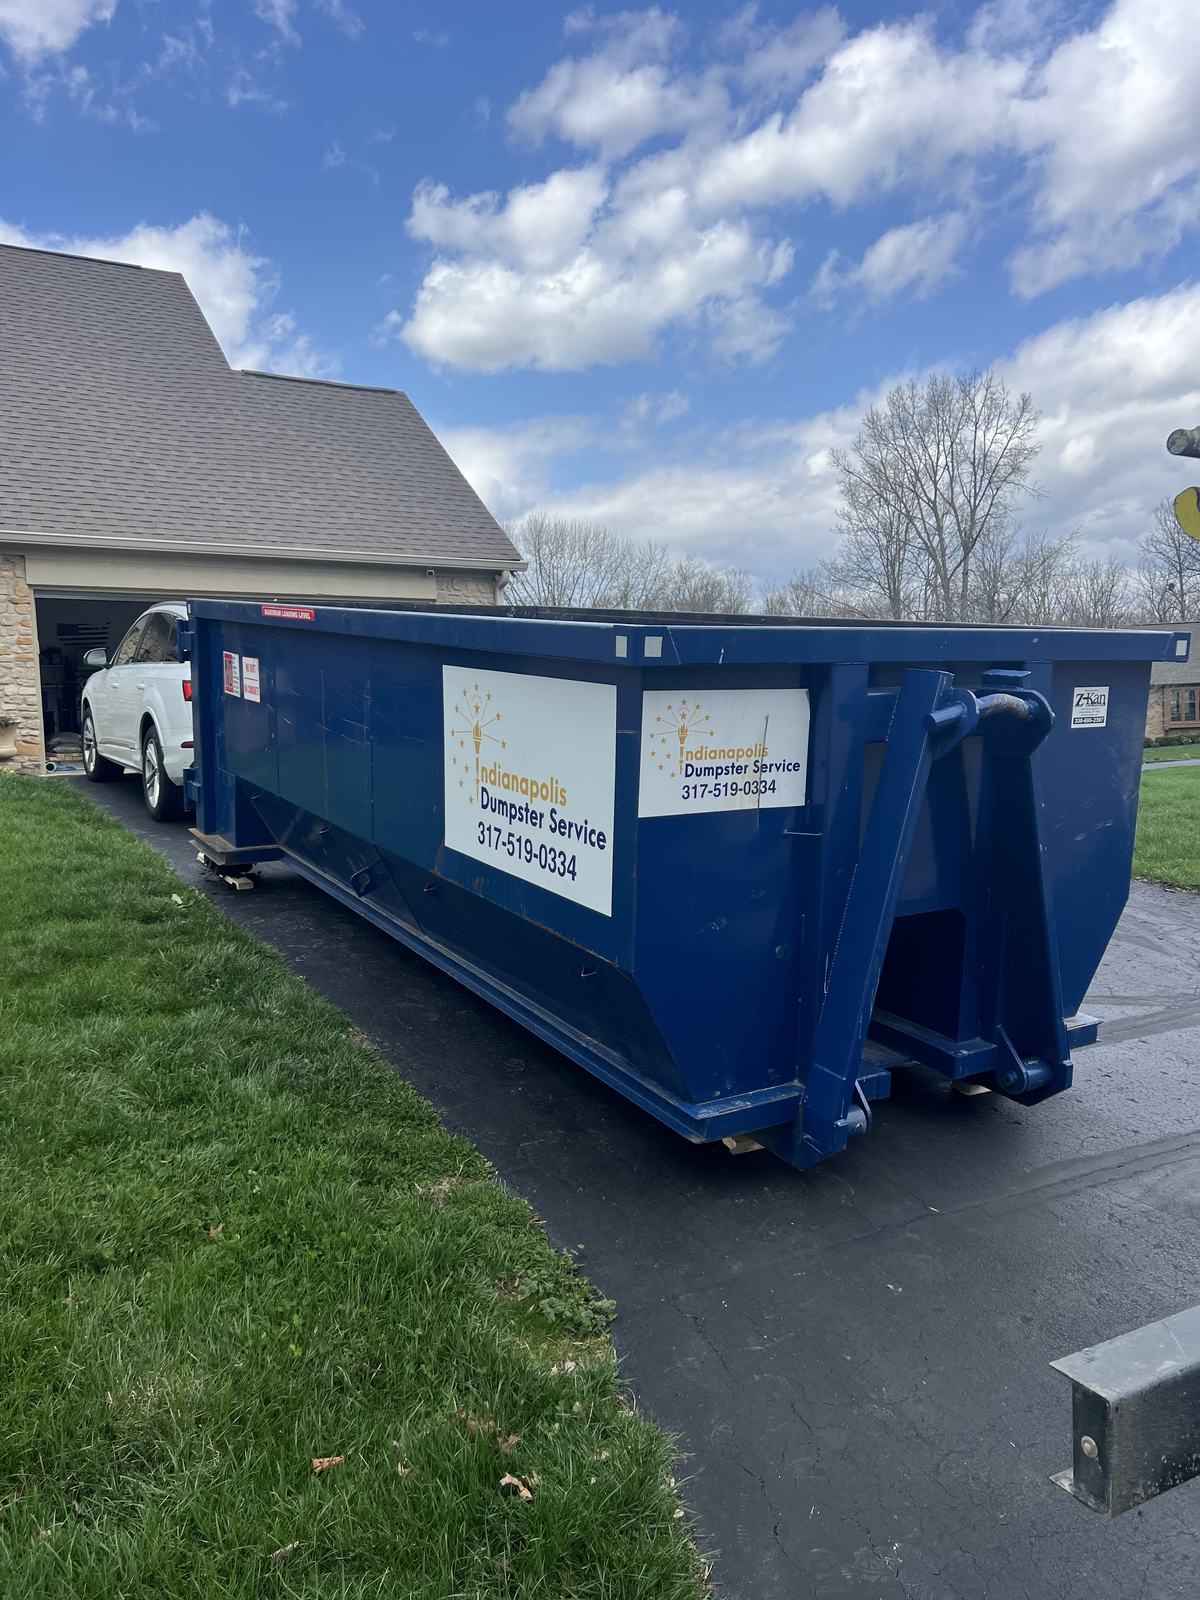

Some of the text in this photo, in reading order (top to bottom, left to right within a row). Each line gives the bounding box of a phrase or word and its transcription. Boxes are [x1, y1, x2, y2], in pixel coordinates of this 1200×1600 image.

[282, 610, 298, 618] LOADING
[299, 612, 311, 620] LEVEL
[1075, 692, 1106, 707] Z-Kan
[680, 744, 769, 764] Indianapolis
[684, 759, 801, 780] Dumpster Service
[476, 757, 567, 807] Indianapolis
[682, 779, 777, 800] 317-519-0334
[481, 786, 607, 851] Dumpster Service
[478, 821, 577, 881] 317-519-0334
